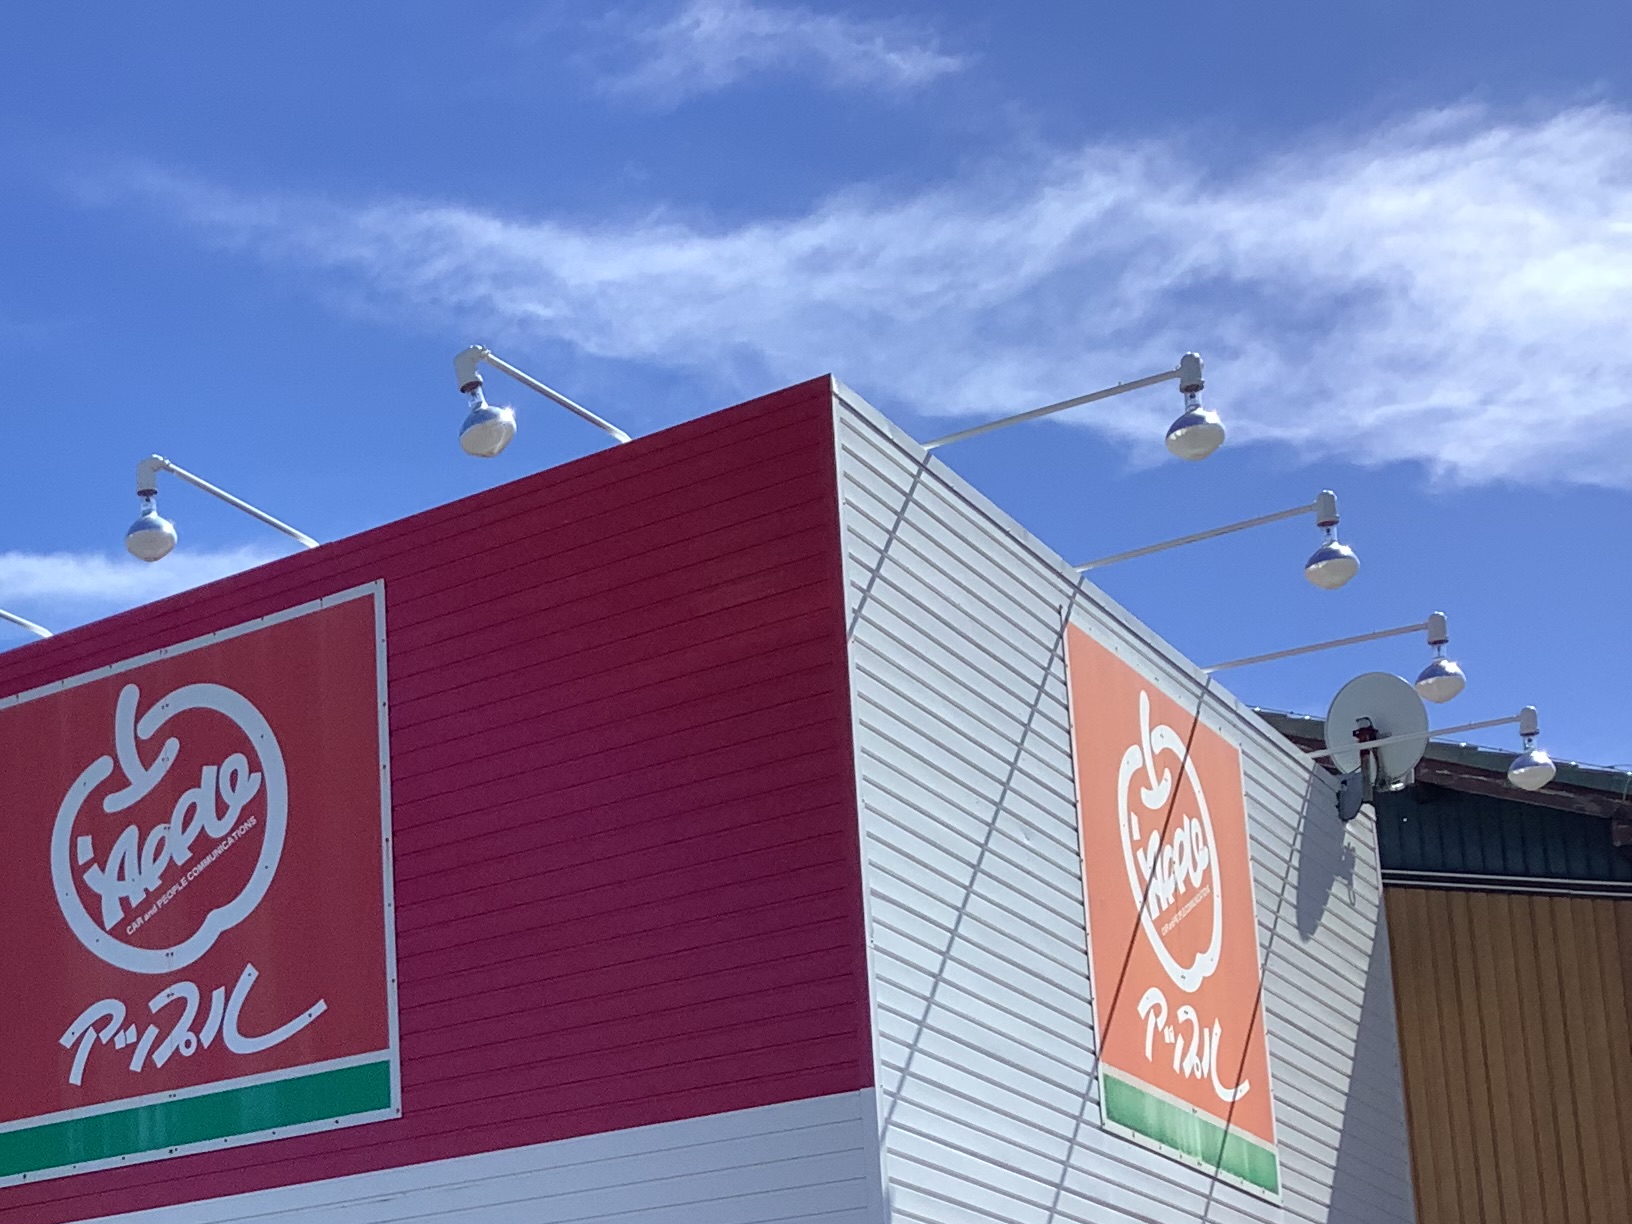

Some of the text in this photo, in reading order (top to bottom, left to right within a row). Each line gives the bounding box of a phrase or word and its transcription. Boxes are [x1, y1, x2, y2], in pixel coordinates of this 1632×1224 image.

[126, 815, 258, 935] CAR and PEOPLE COMMUNICATIONS
[60, 963, 328, 1086] アップル
[1137, 986, 1250, 1102] アップル
